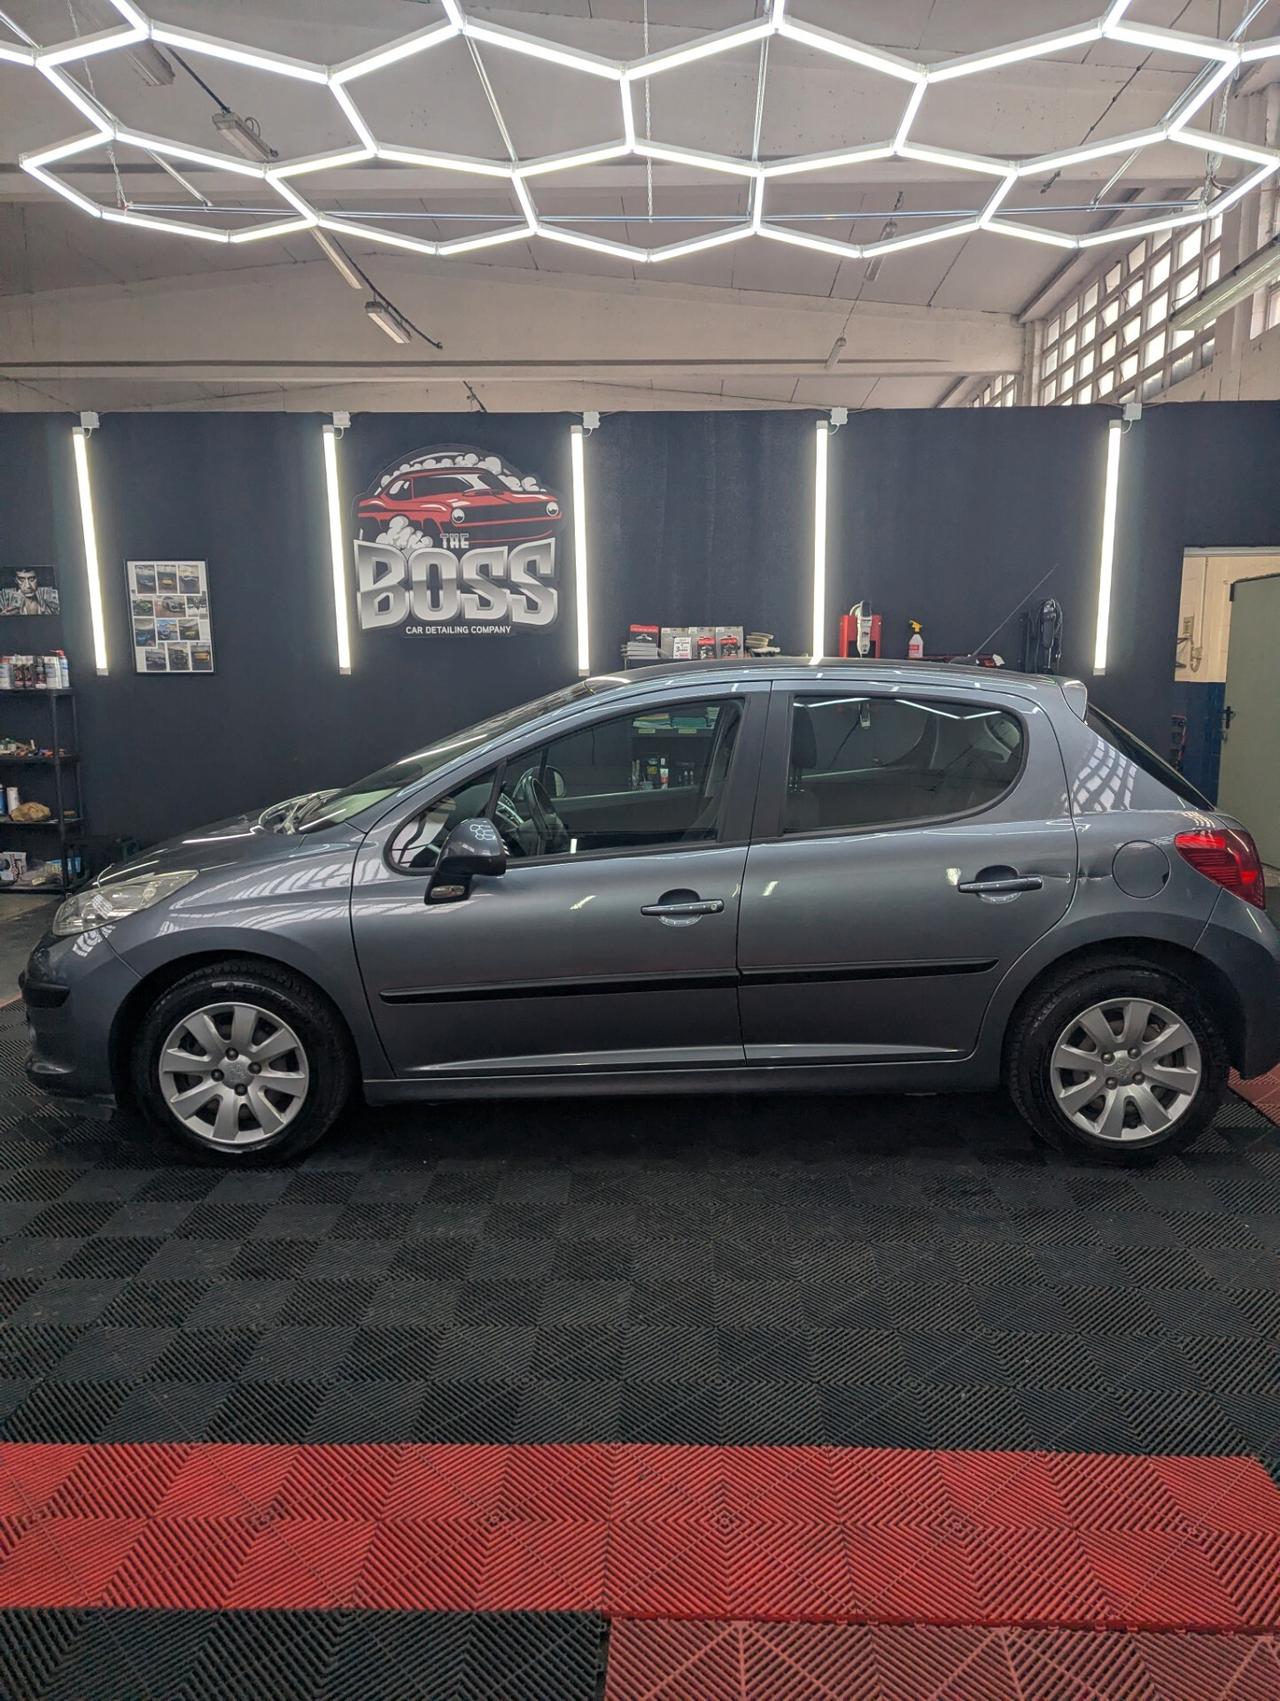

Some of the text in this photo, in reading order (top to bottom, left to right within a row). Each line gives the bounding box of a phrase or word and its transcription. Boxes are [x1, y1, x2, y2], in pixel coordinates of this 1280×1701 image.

[440, 533, 469, 548] THE
[353, 538, 557, 629] BOSS
[405, 625, 512, 634] CAR DETAILING COMPANY
